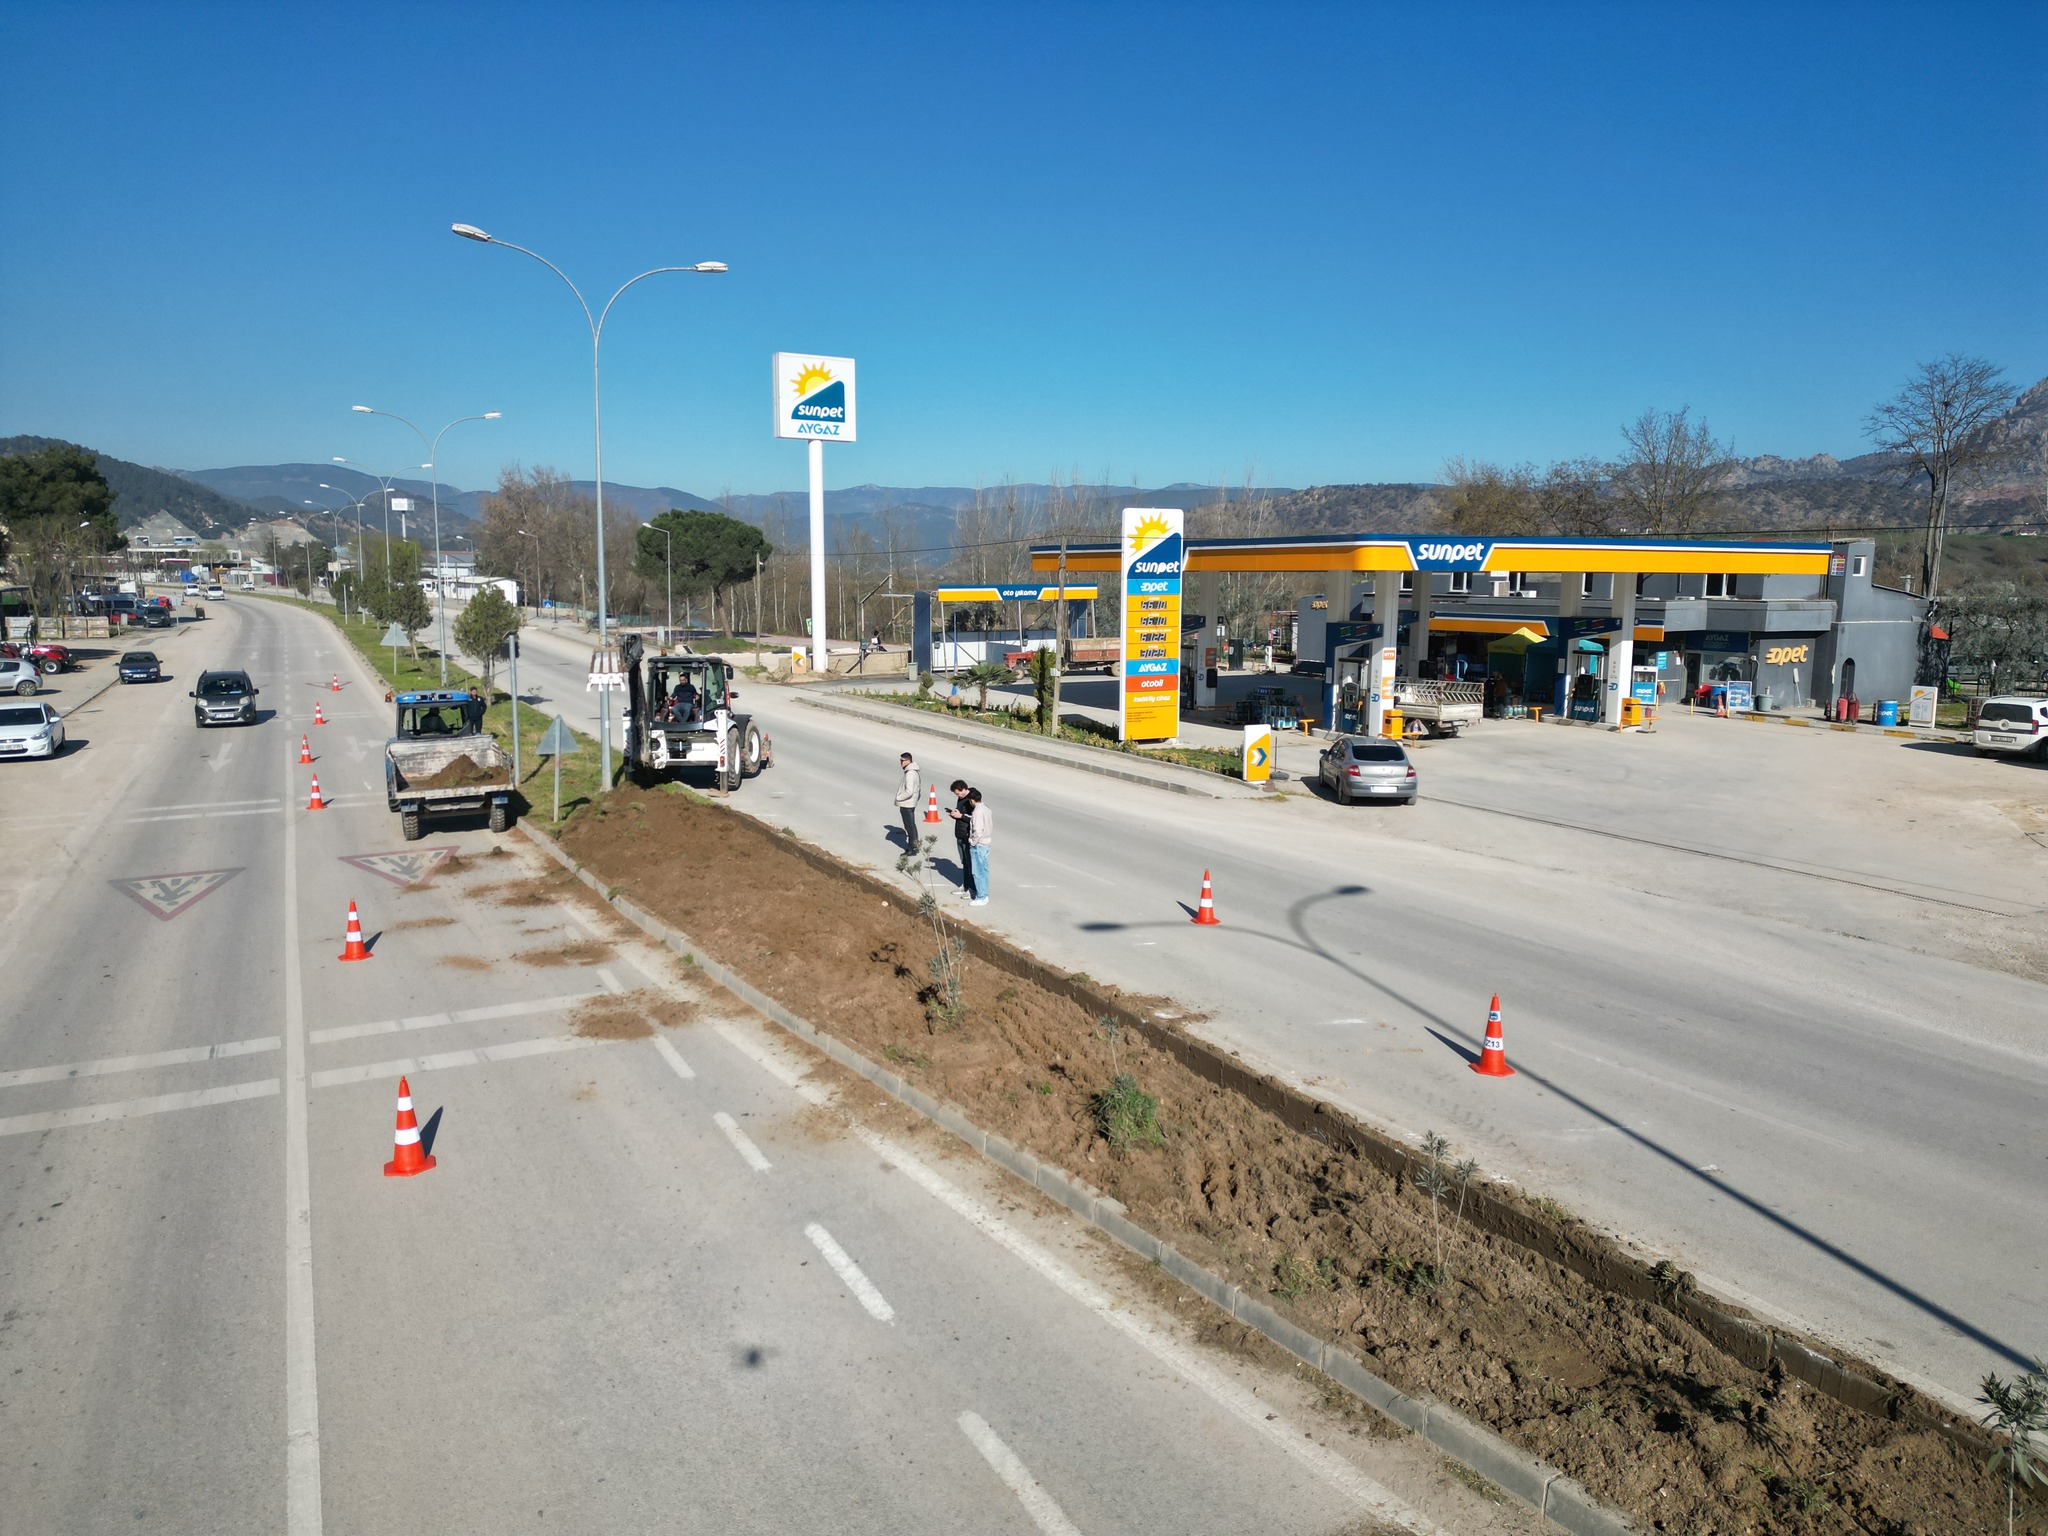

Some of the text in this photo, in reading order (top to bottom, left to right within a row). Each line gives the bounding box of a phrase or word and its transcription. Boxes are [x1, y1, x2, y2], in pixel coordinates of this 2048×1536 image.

[798, 405, 844, 418] sunpet
[797, 423, 840, 435] AYGAZ
[1417, 543, 1484, 563] sunpet
[1135, 561, 1180, 574] sunpet
[1140, 581, 1168, 592] opet
[1705, 634, 1729, 642] AYGAZ
[1765, 644, 1809, 666] opet
[1138, 662, 1168, 673] AYGAZ
